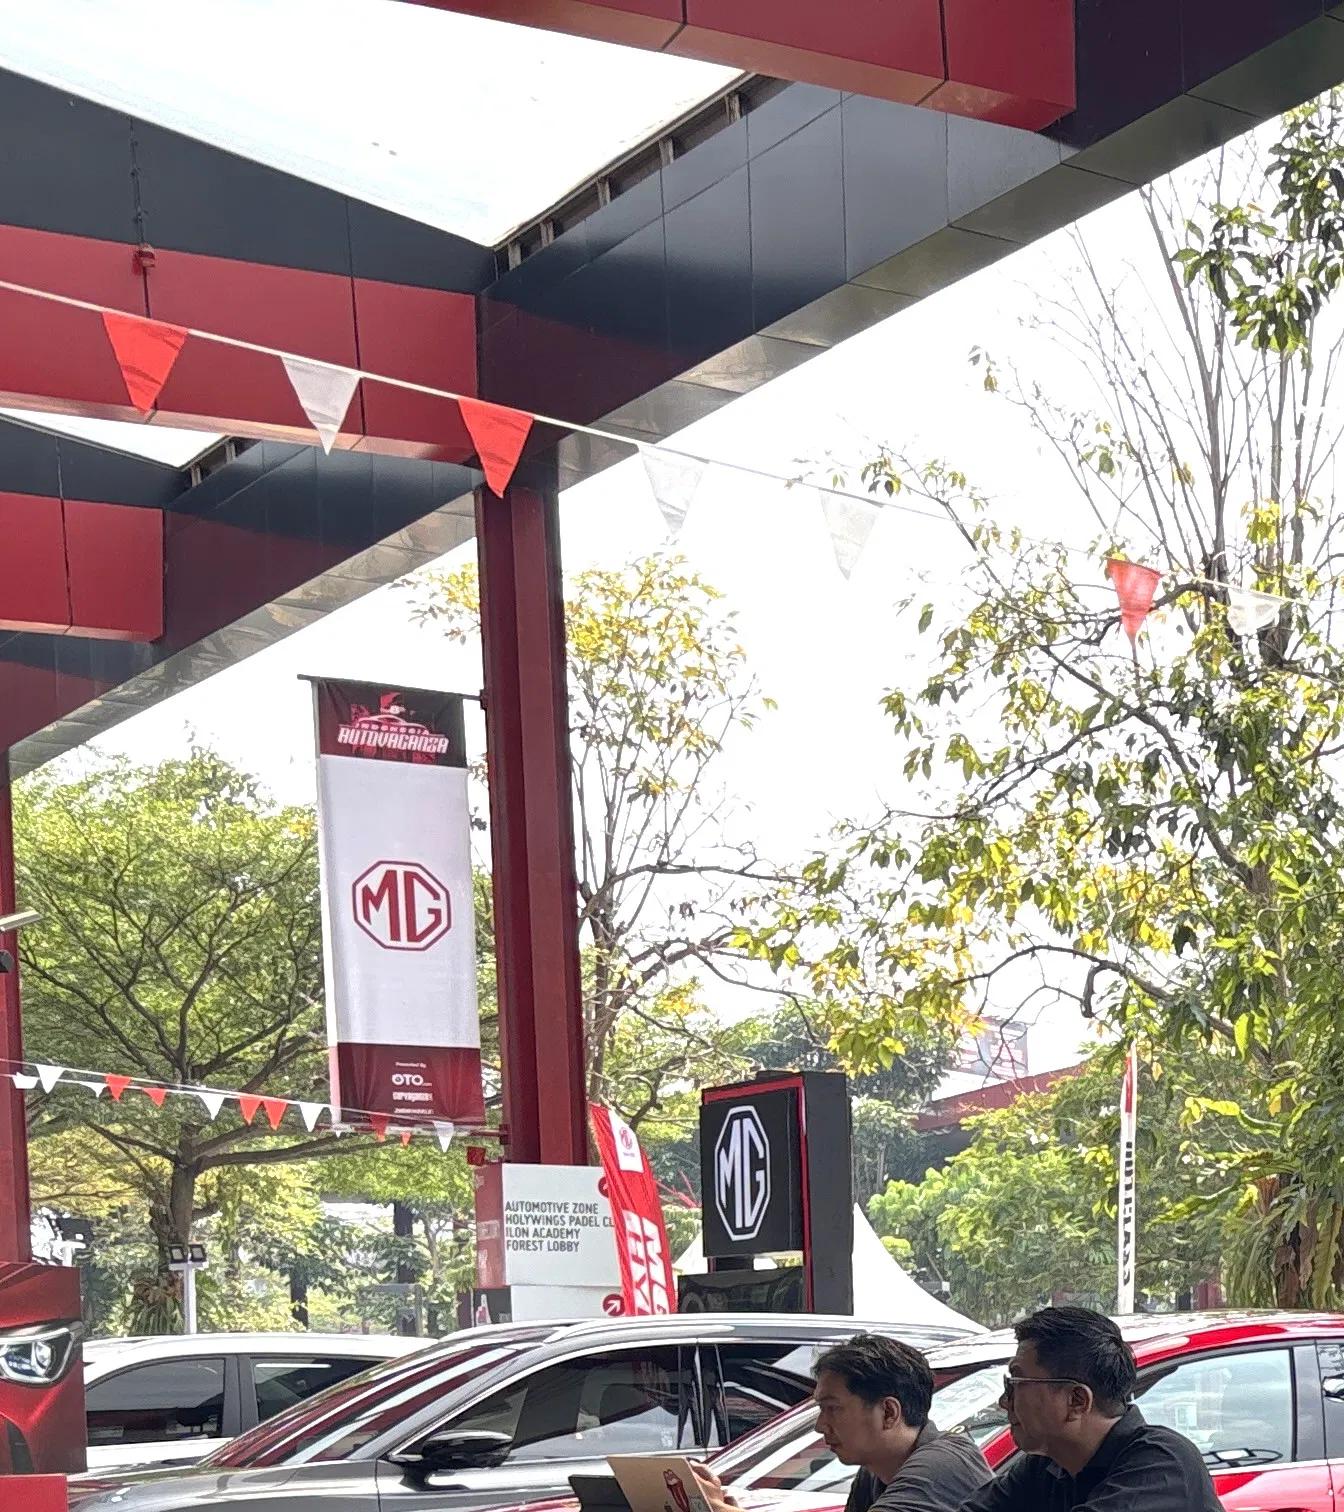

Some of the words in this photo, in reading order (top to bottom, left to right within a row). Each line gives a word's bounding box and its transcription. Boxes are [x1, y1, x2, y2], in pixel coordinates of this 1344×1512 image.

[362, 868, 442, 945] MG
[718, 1118, 767, 1230] MG
[505, 1201, 569, 1214] AUTOMOTIVE
[573, 1202, 599, 1214] ZONE
[505, 1214, 566, 1227] HOLYWINGS
[569, 1216, 600, 1228] PADEL
[505, 1227, 529, 1239] ILON
[532, 1228, 580, 1239] ACADEMY
[506, 1240, 543, 1252] FOREST
[547, 1240, 580, 1252] LOBBY
